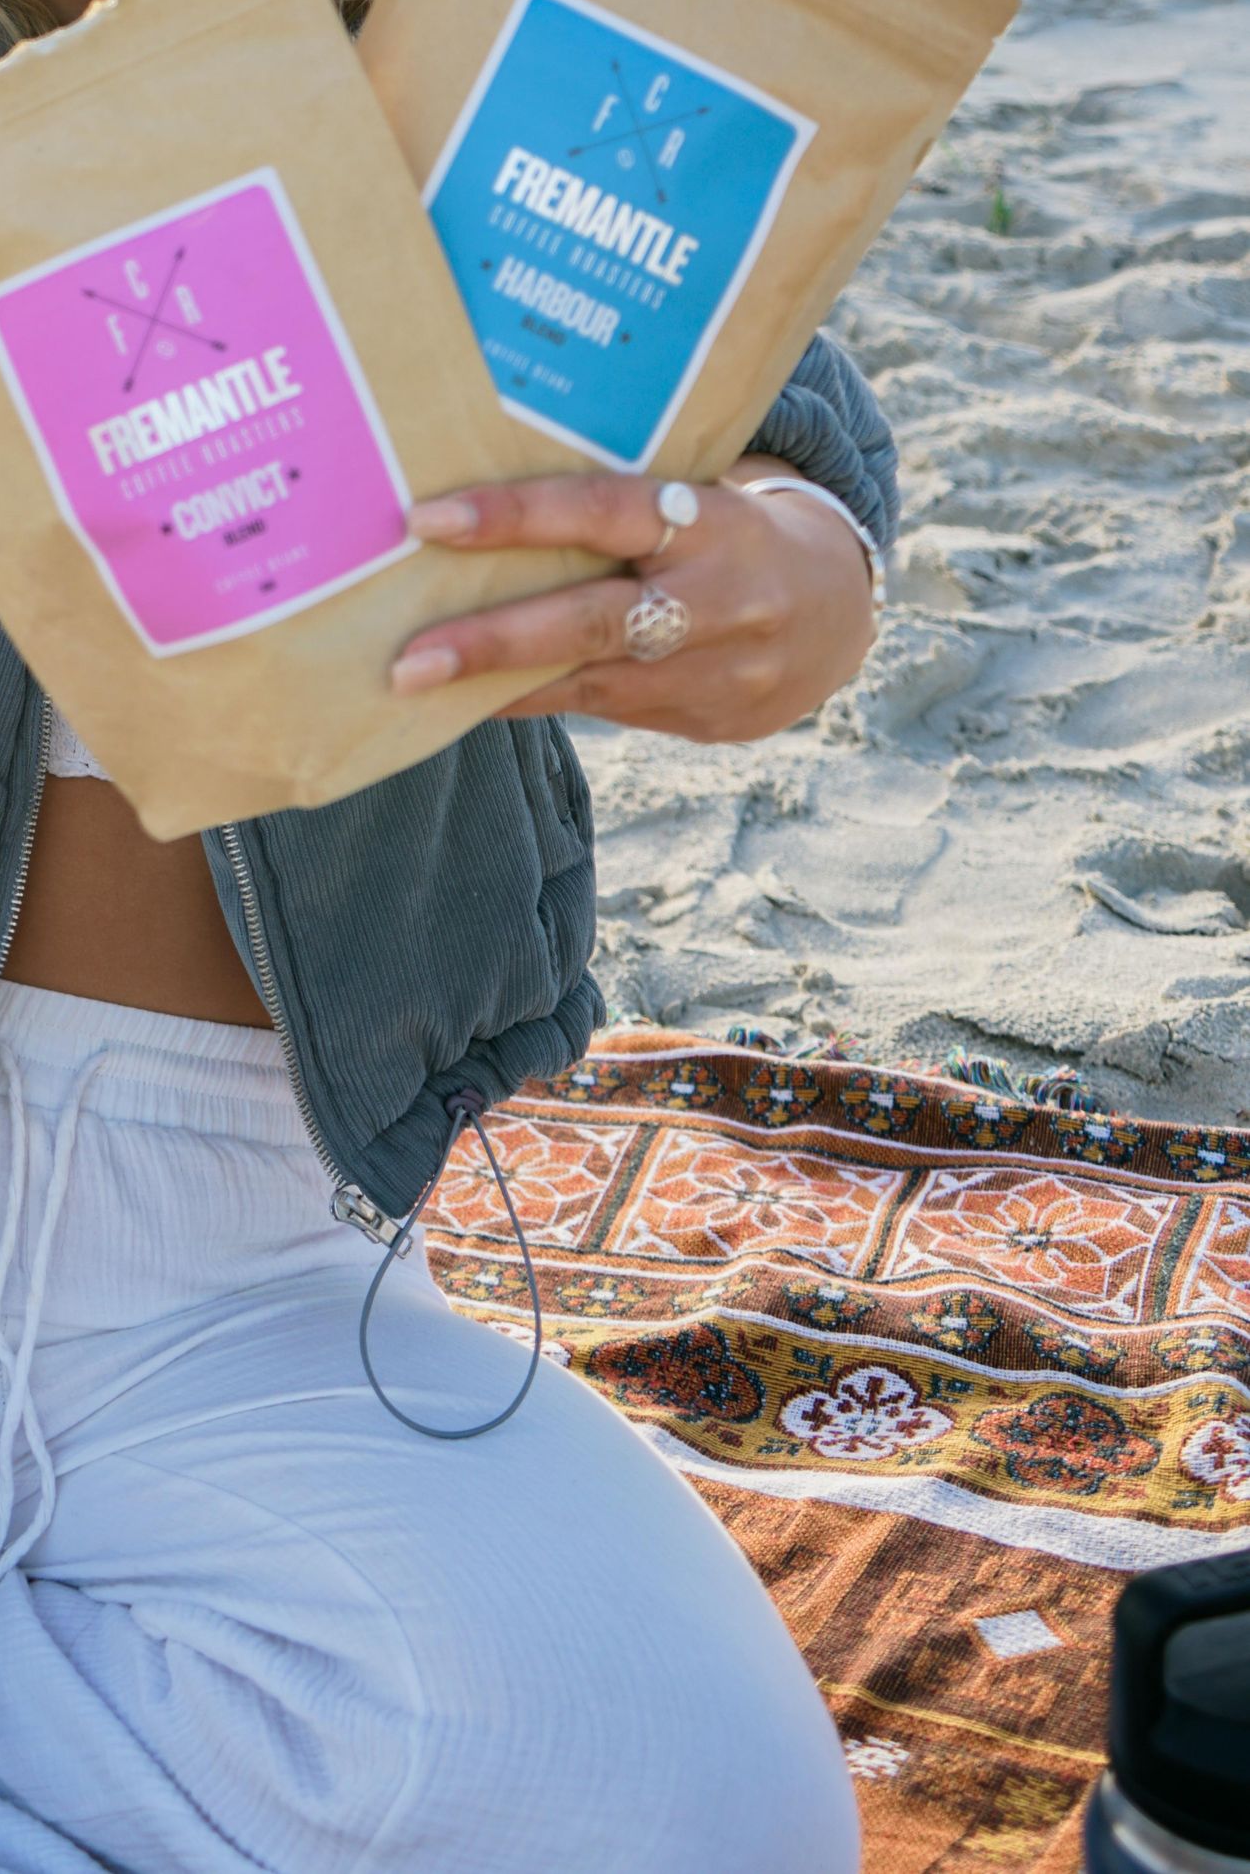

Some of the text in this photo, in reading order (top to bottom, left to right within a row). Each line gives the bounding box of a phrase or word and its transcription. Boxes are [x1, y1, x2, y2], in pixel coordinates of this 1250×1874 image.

[592, 95, 618, 132] F
[645, 74, 669, 112] C
[494, 147, 698, 285] FREMANTLE
[124, 261, 148, 299] C
[494, 256, 618, 346] HARBOUR
[107, 315, 126, 353] F
[89, 348, 300, 474] FREMANTLE
[173, 462, 288, 540] CONVICT
